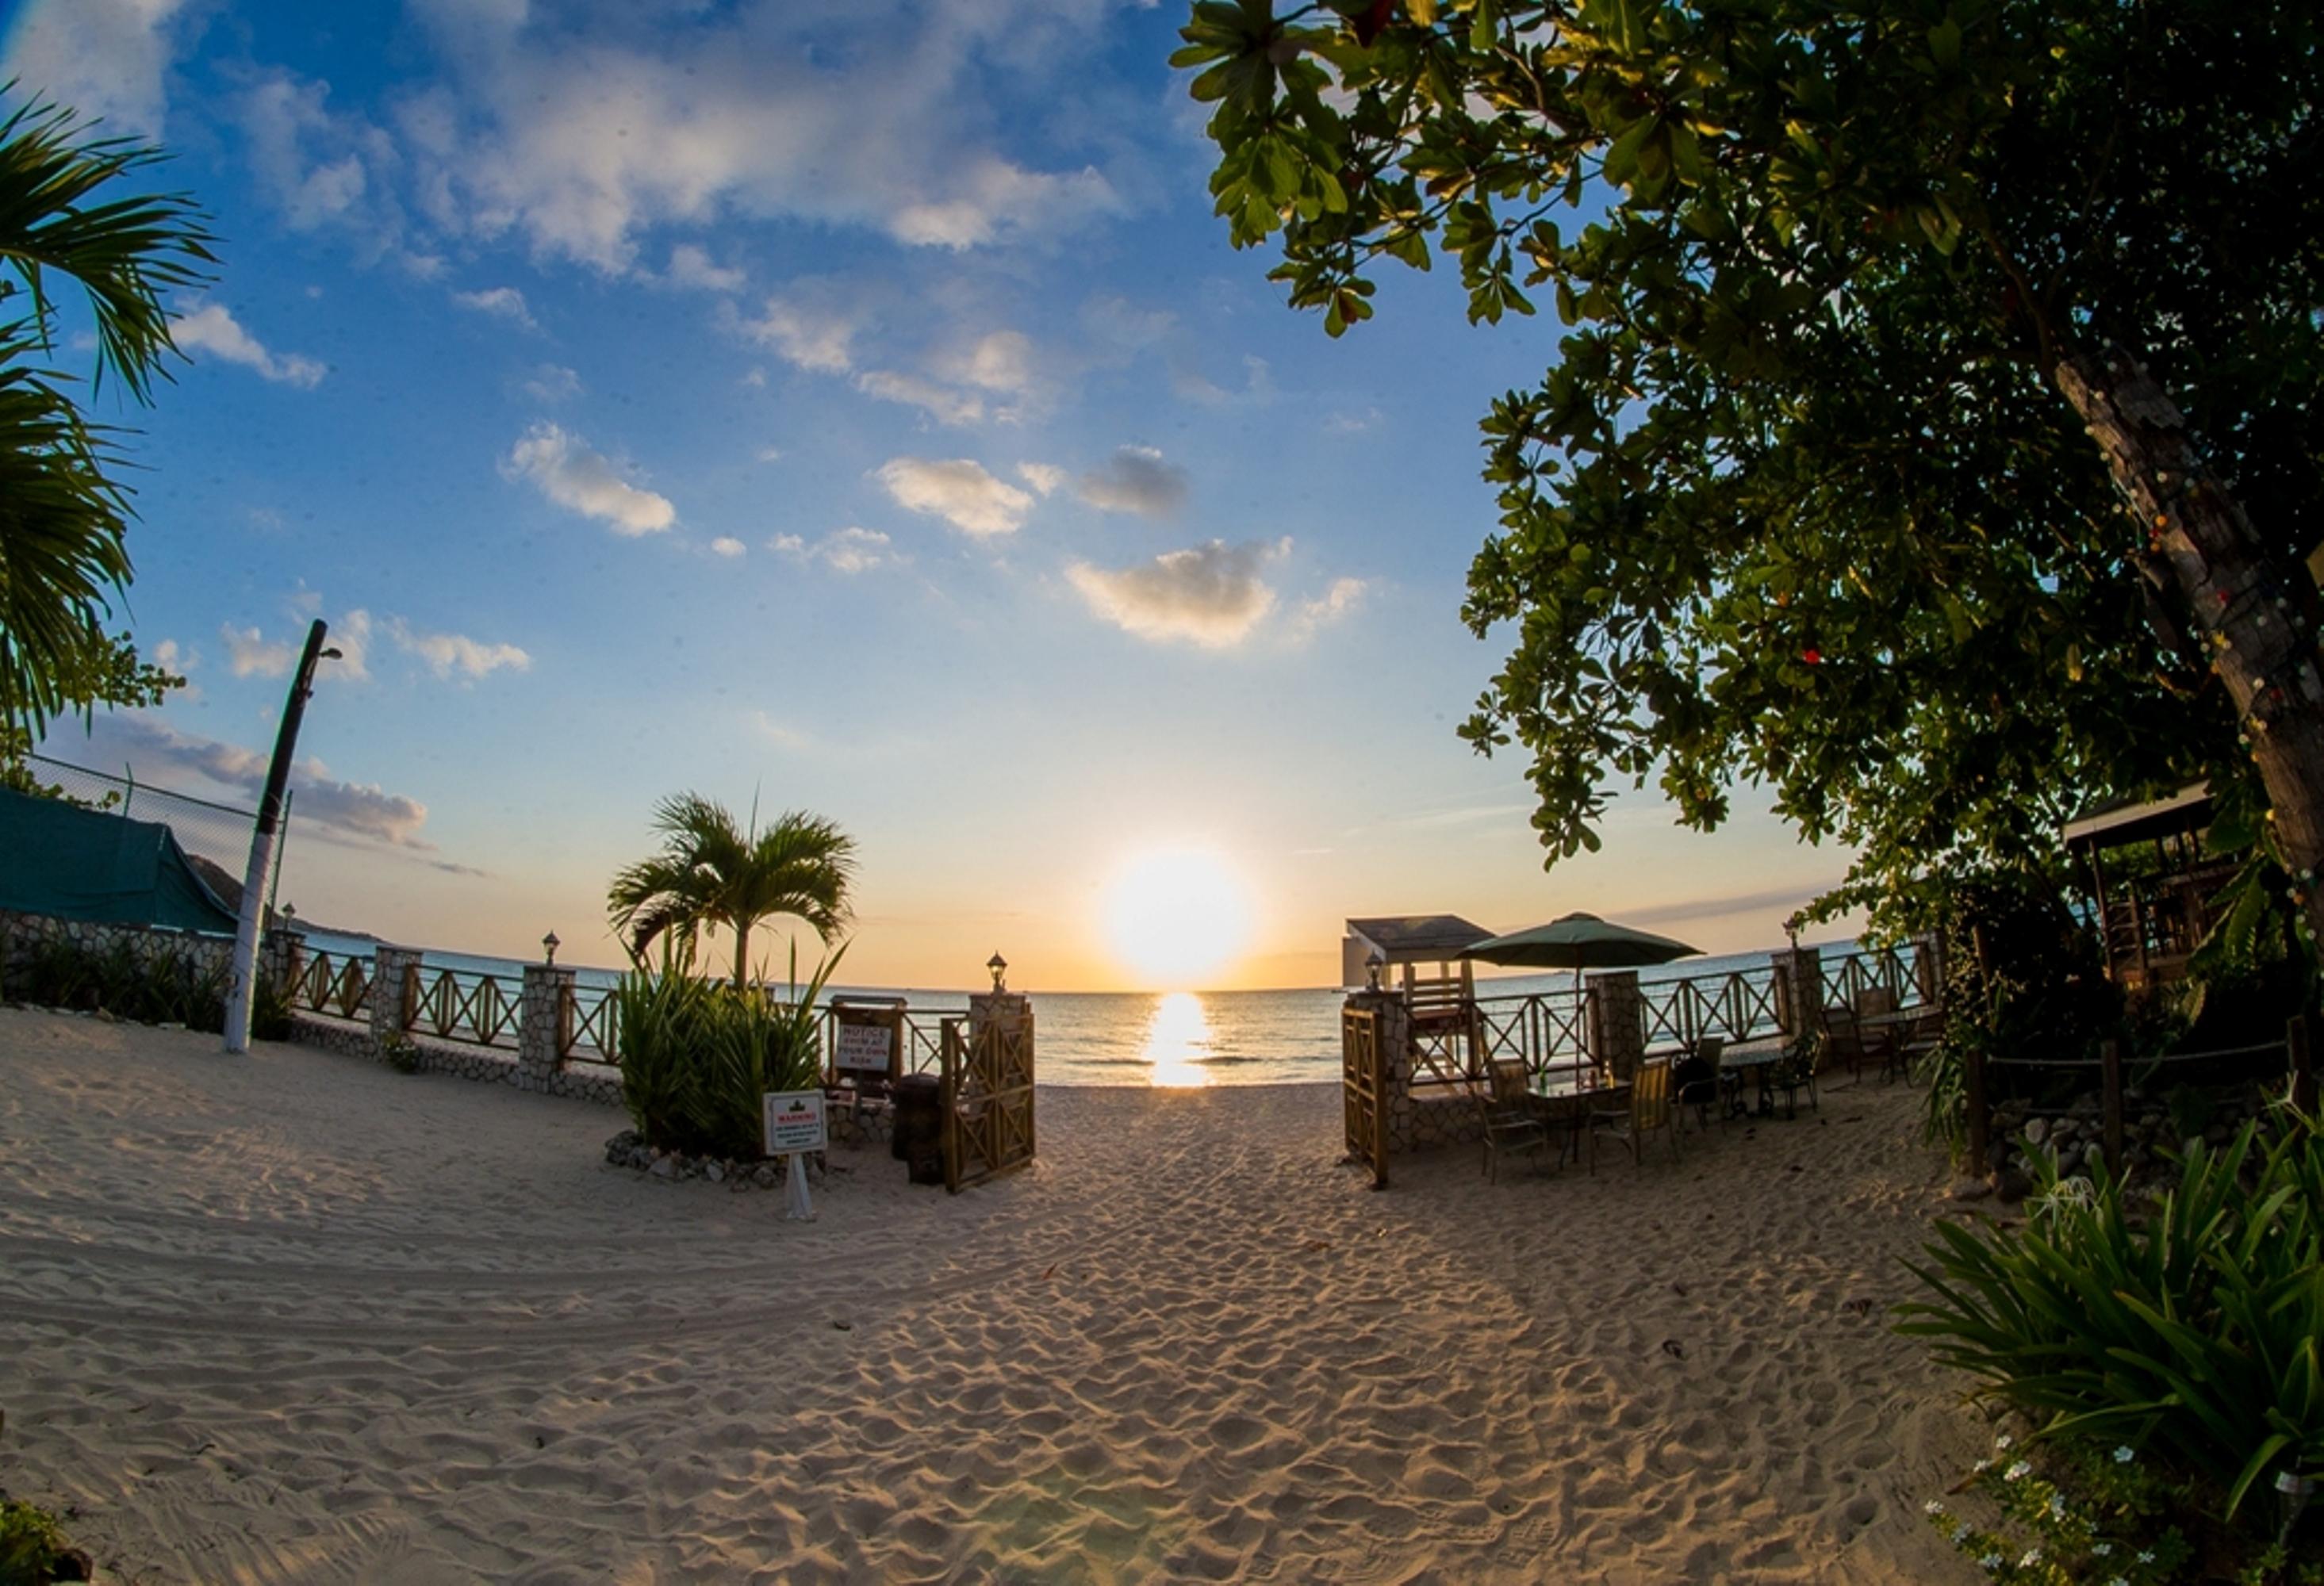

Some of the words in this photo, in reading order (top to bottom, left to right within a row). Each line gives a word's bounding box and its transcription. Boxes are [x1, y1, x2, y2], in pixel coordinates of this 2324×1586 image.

[843, 1027, 884, 1037] NOTICE
[838, 1046, 863, 1055] YOUR
[778, 1112, 816, 1124] WARNING
